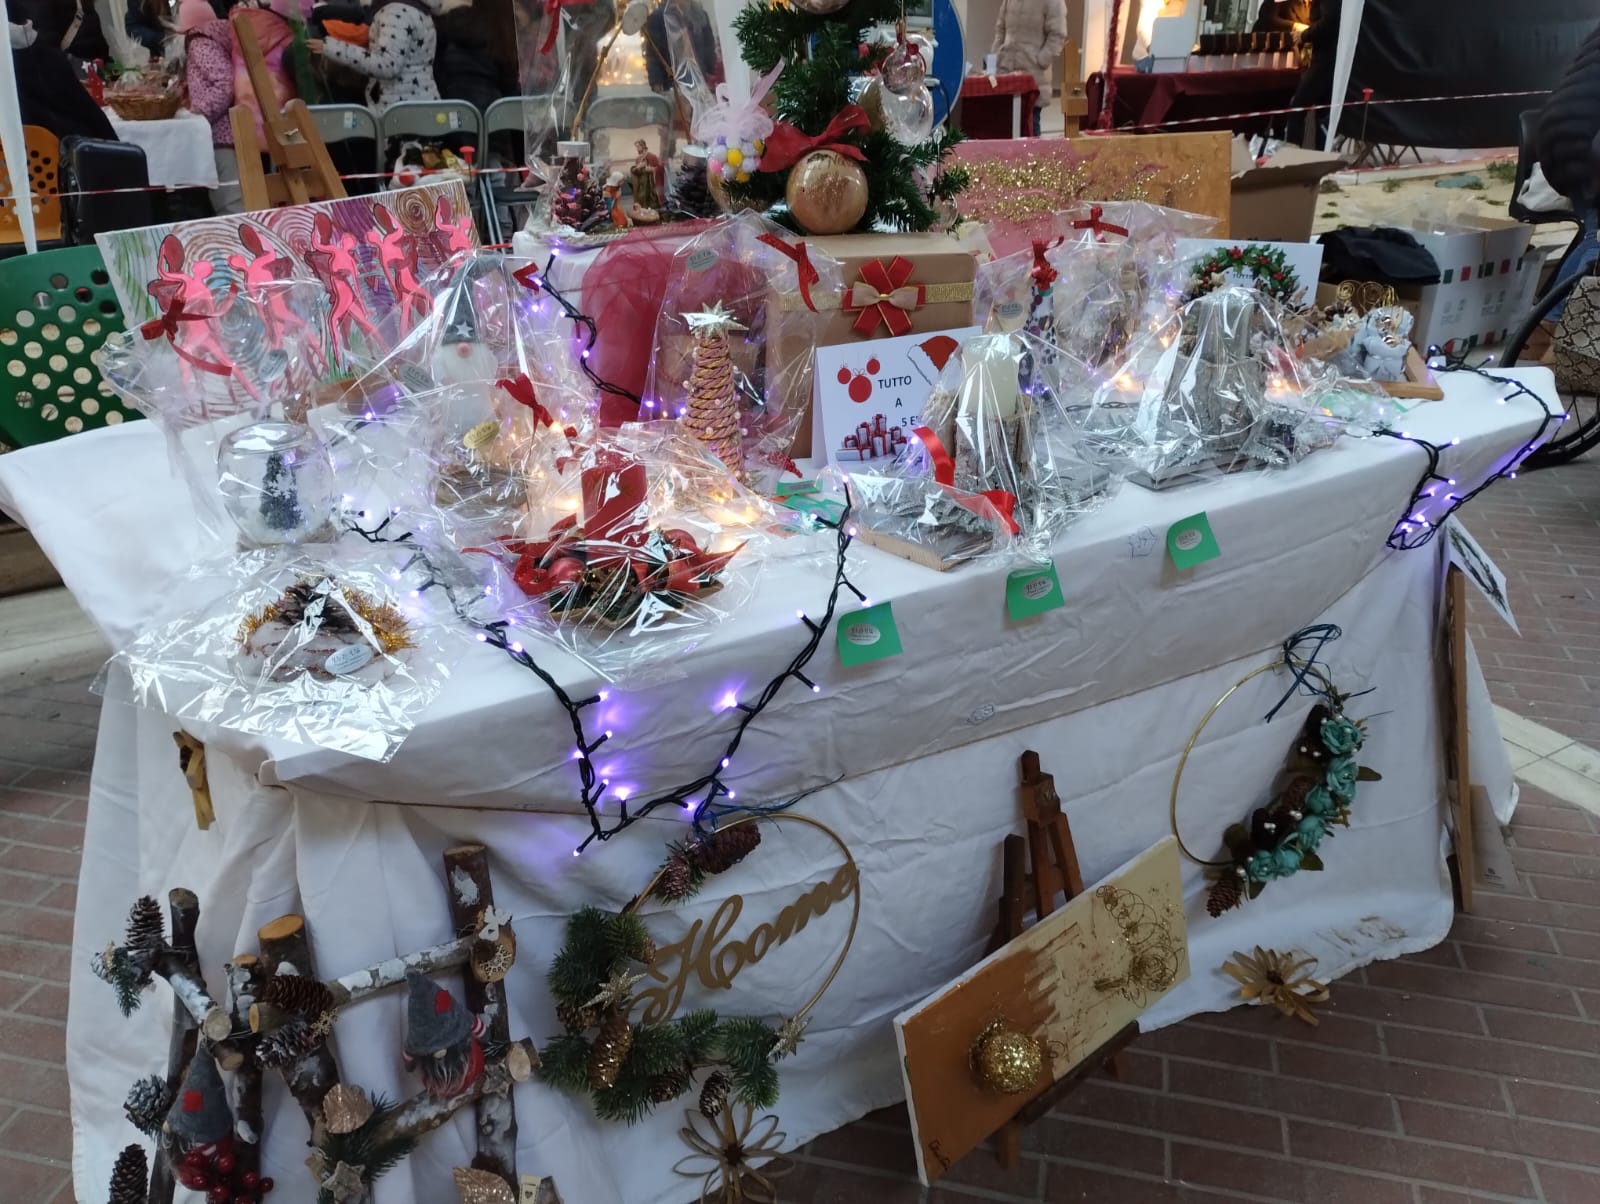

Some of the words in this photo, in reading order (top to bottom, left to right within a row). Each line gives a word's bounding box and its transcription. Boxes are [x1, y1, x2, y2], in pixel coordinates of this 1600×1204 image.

[878, 376, 912, 389] TUTTO
[895, 397, 902, 408] A
[901, 417, 908, 427] 5
[624, 860, 860, 1026] Home
